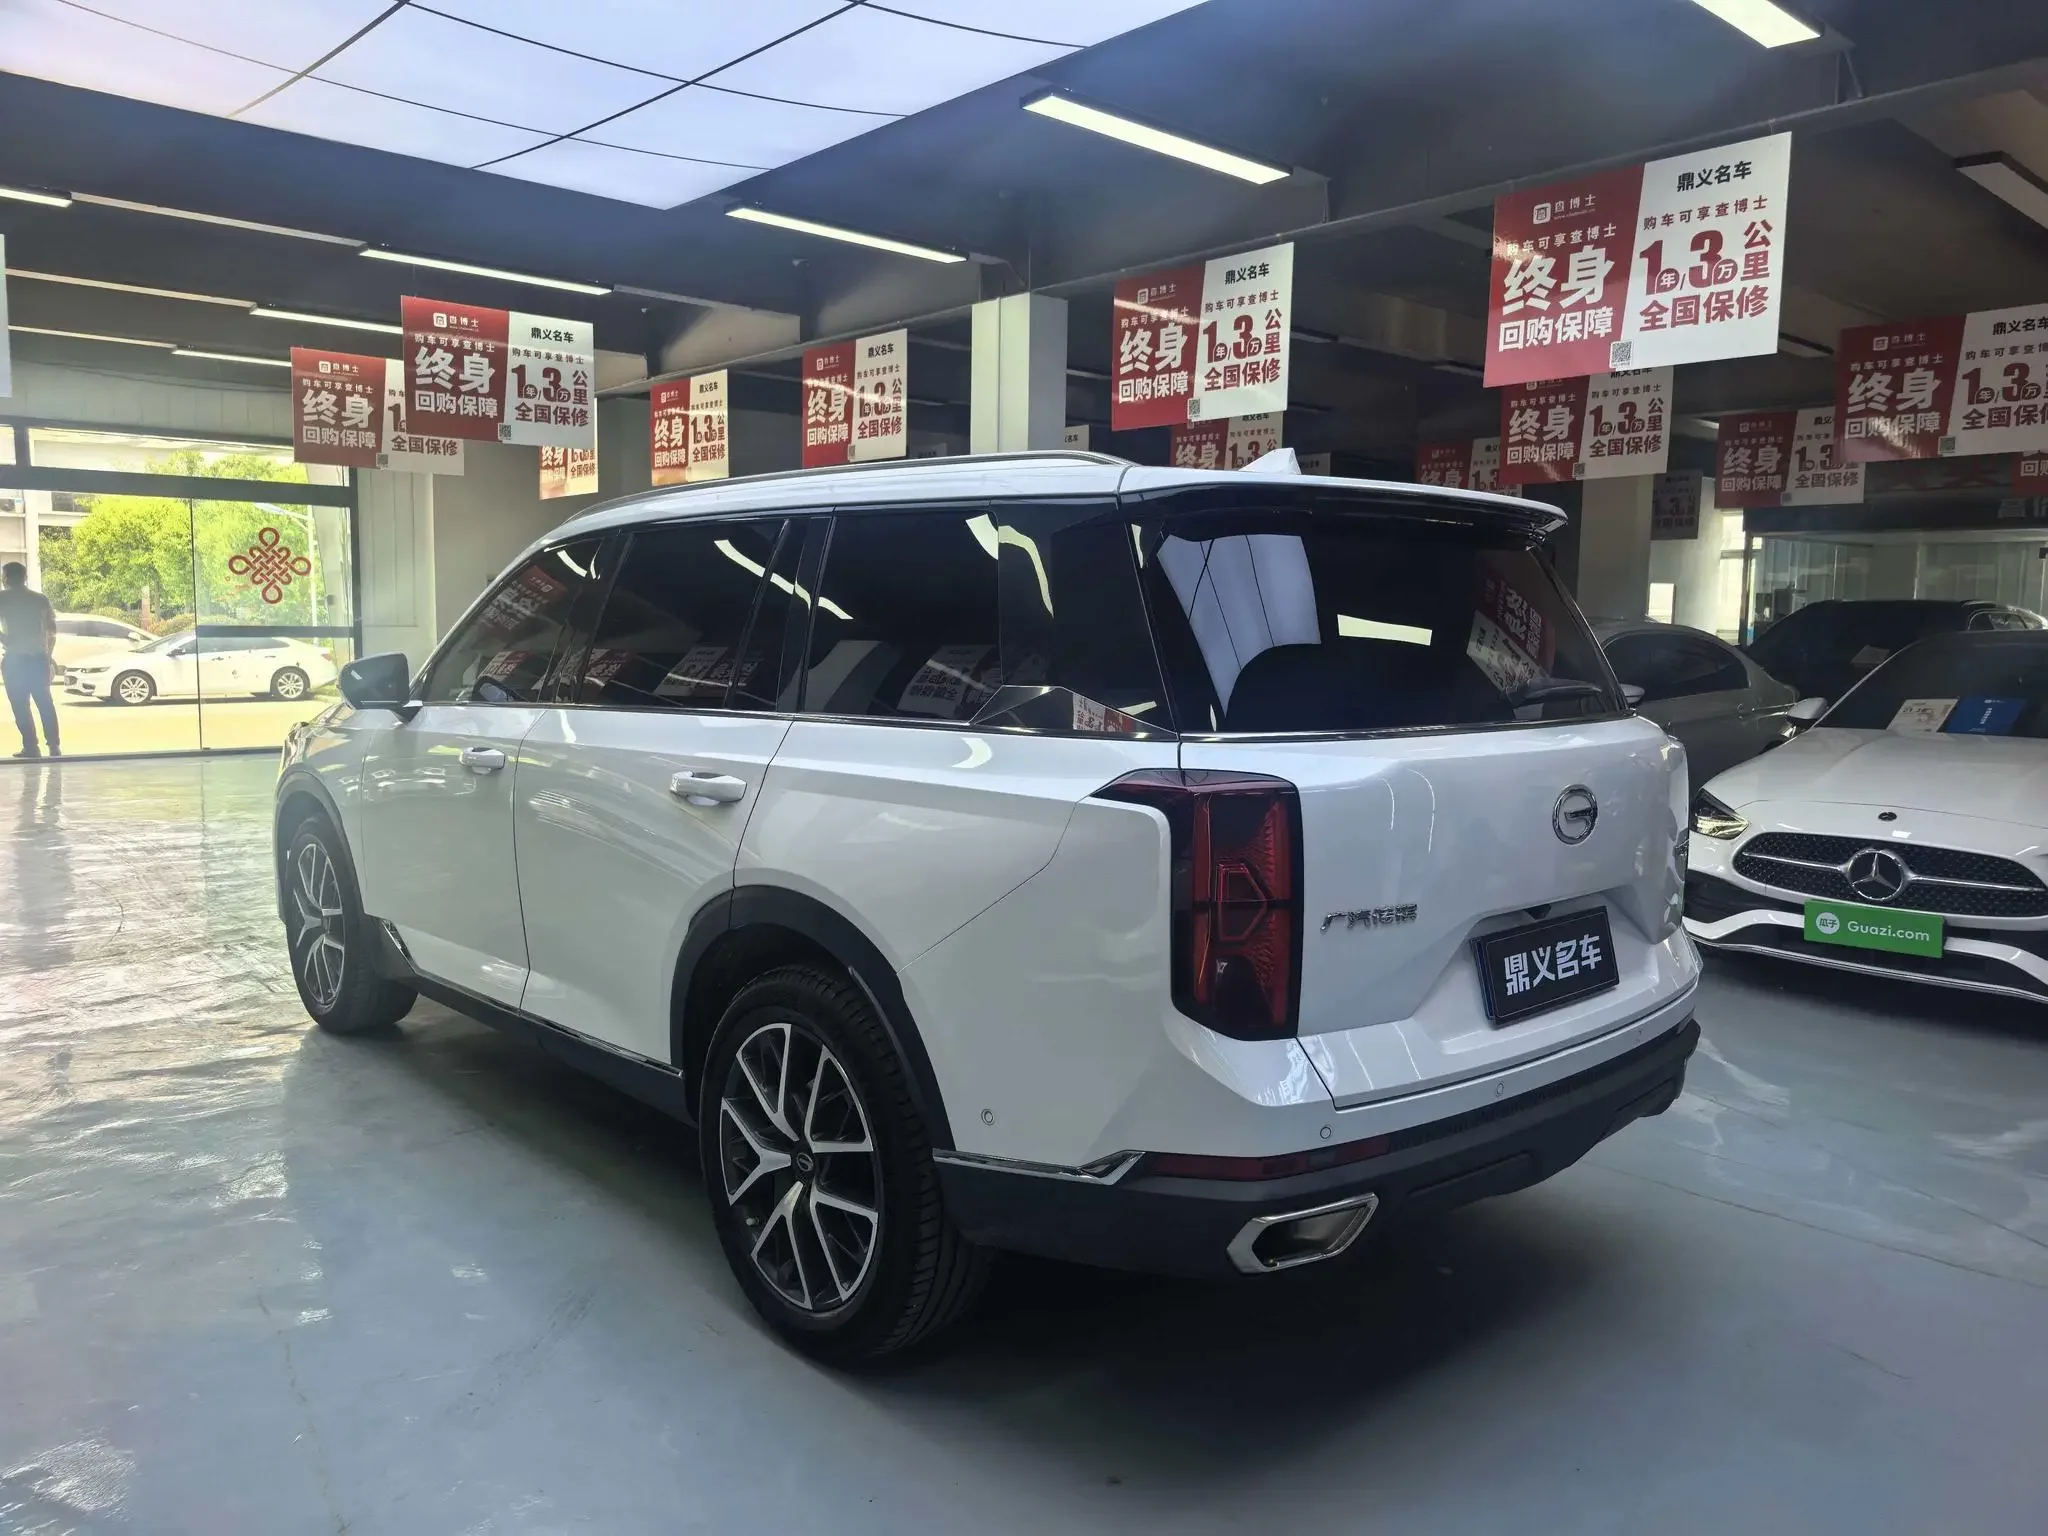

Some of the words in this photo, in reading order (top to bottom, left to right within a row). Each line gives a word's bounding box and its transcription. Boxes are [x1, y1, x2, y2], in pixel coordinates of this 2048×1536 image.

[1676, 160, 1752, 192] 鼎义名车
[1643, 195, 1768, 230] 购车可享查博士
[1506, 223, 1617, 255] 购车可享查博士
[1225, 263, 1270, 284] 鼎义名车
[1502, 244, 1615, 316] 终身
[1205, 289, 1280, 312] 购车可享查博士
[1639, 285, 1769, 332] 全国保修
[531, 327, 574, 343] 鼎义名车
[1498, 306, 1613, 351] 回购保障
[1993, 316, 2048, 335] 鼎义名车
[414, 332, 495, 353] 购车可享查博士
[512, 347, 584, 365] 购车可享查博士
[1120, 322, 1188, 375] 终身
[415, 346, 495, 394] 终身
[1204, 358, 1281, 392] 全国保修
[302, 378, 373, 394] 购车可享查博士
[1118, 370, 1188, 403] 回购保障
[1847, 367, 1941, 413] 终身
[302, 389, 374, 429] 终身
[415, 390, 498, 419] 回购保障
[515, 402, 589, 427] 全国保修
[807, 387, 848, 425] 终身
[302, 426, 376, 449] 回购保障
[654, 415, 685, 449] 终身
[807, 422, 849, 447] 回购保障
[857, 416, 902, 440] 全国保修
[1509, 405, 1574, 443] 终身
[1844, 411, 1940, 439] 回购保障
[391, 435, 458, 457] 全国保修
[692, 445, 725, 463] 全国保修
[1506, 442, 1575, 465] 回购保障
[1589, 435, 1662, 458] 全国保修
[1723, 444, 1782, 475] 终身
[1847, 921, 1930, 941] Guazi.com
[1503, 933, 1602, 996] 鼎义名车
